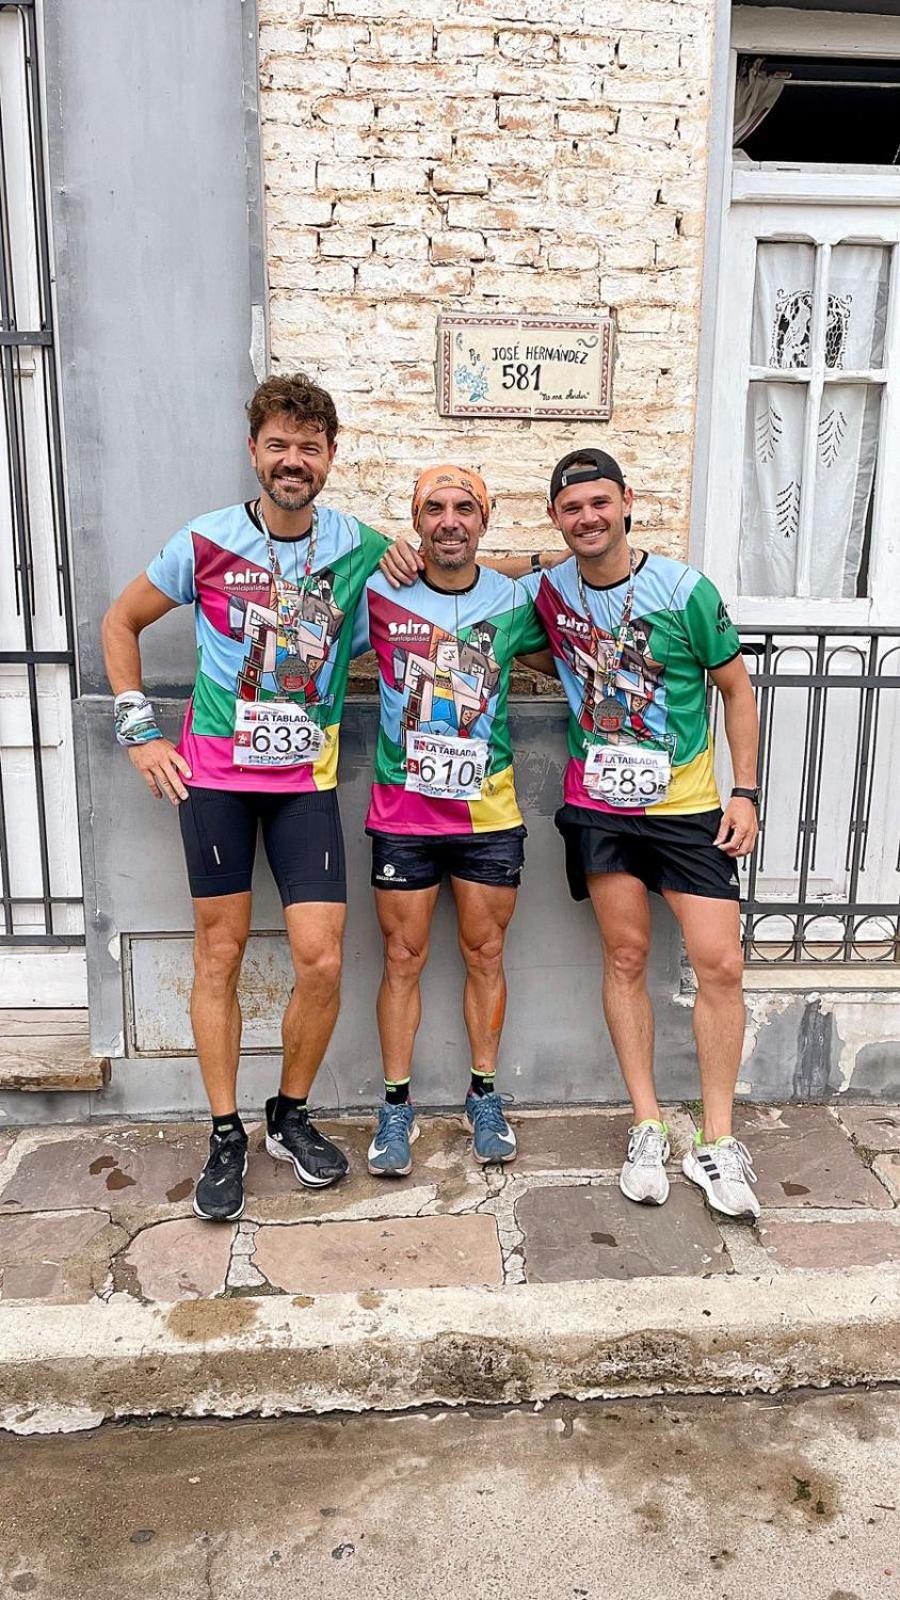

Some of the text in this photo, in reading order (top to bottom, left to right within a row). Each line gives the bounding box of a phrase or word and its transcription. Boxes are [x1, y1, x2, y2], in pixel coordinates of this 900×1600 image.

[469, 341, 589, 366] Pje JOSÉ HERNÁNDEZ
[502, 363, 542, 391] 581
[258, 714, 269, 722] LA
[252, 725, 312, 753] 633
[426, 745, 437, 753] LA
[439, 746, 477, 757] TABLADA
[420, 755, 476, 787] 610
[618, 756, 658, 765] TABLADA
[600, 767, 658, 795] 583
